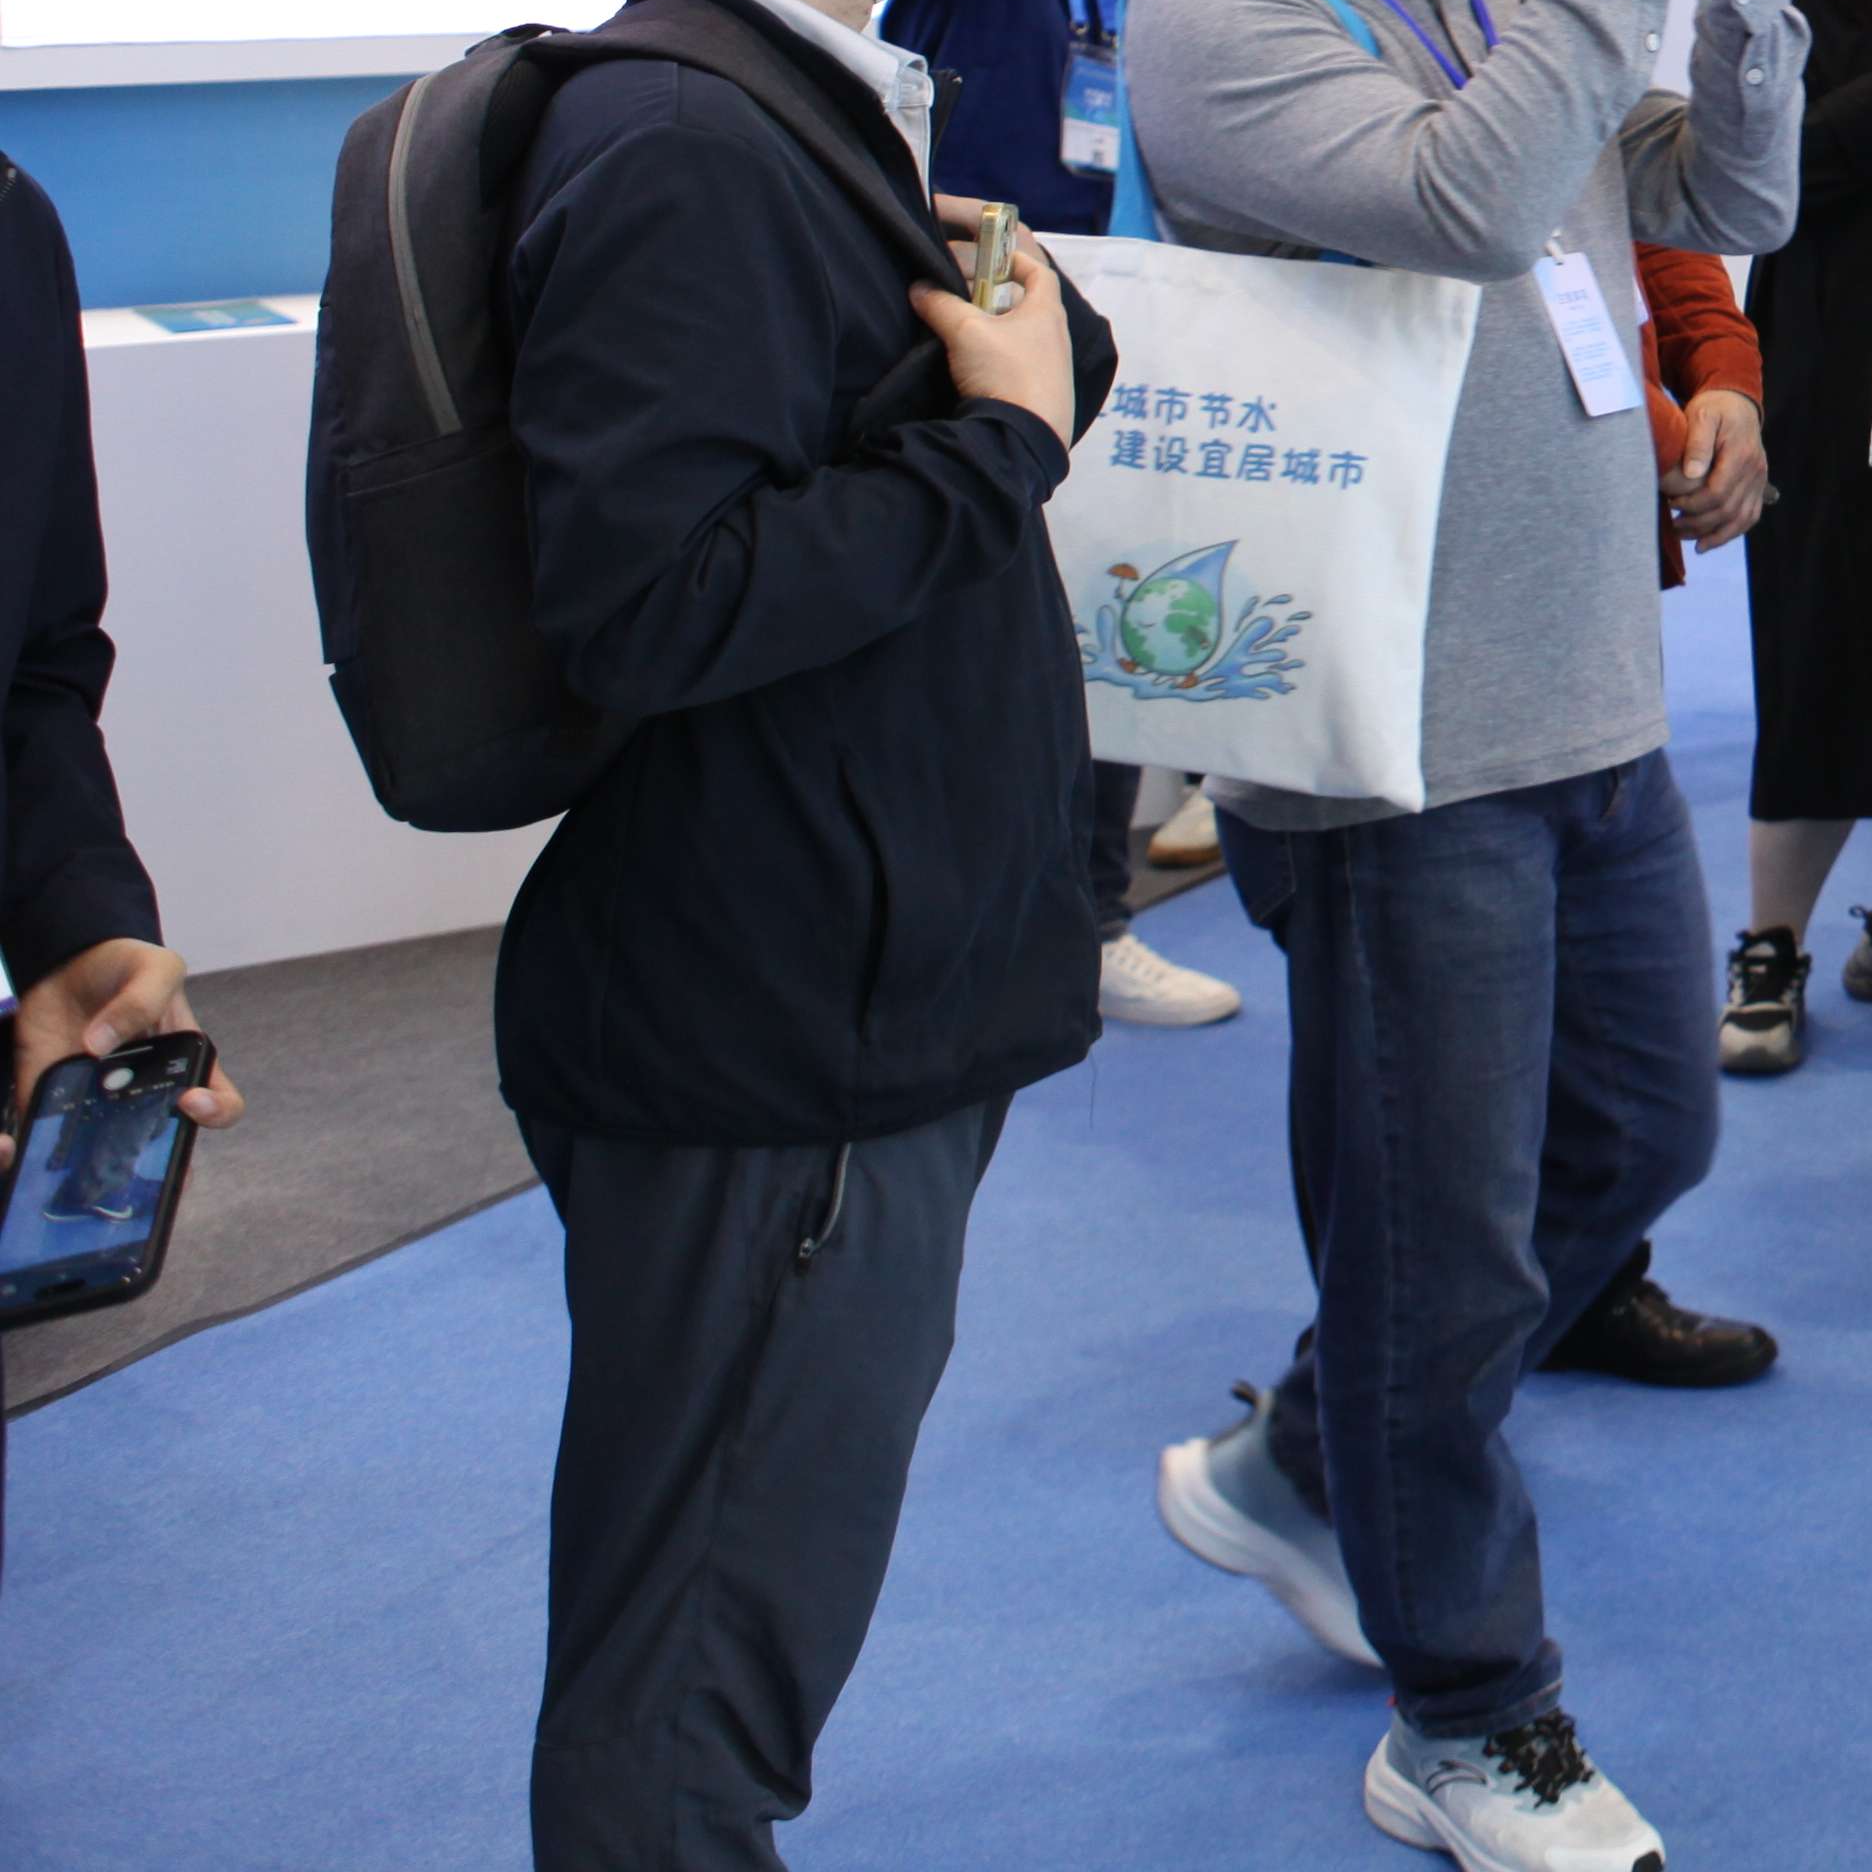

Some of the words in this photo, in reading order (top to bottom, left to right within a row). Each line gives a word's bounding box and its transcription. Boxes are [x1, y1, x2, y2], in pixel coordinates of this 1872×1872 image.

[1096, 382, 1277, 434] 城市节水
[1109, 429, 1369, 490] 建设宜居城市
